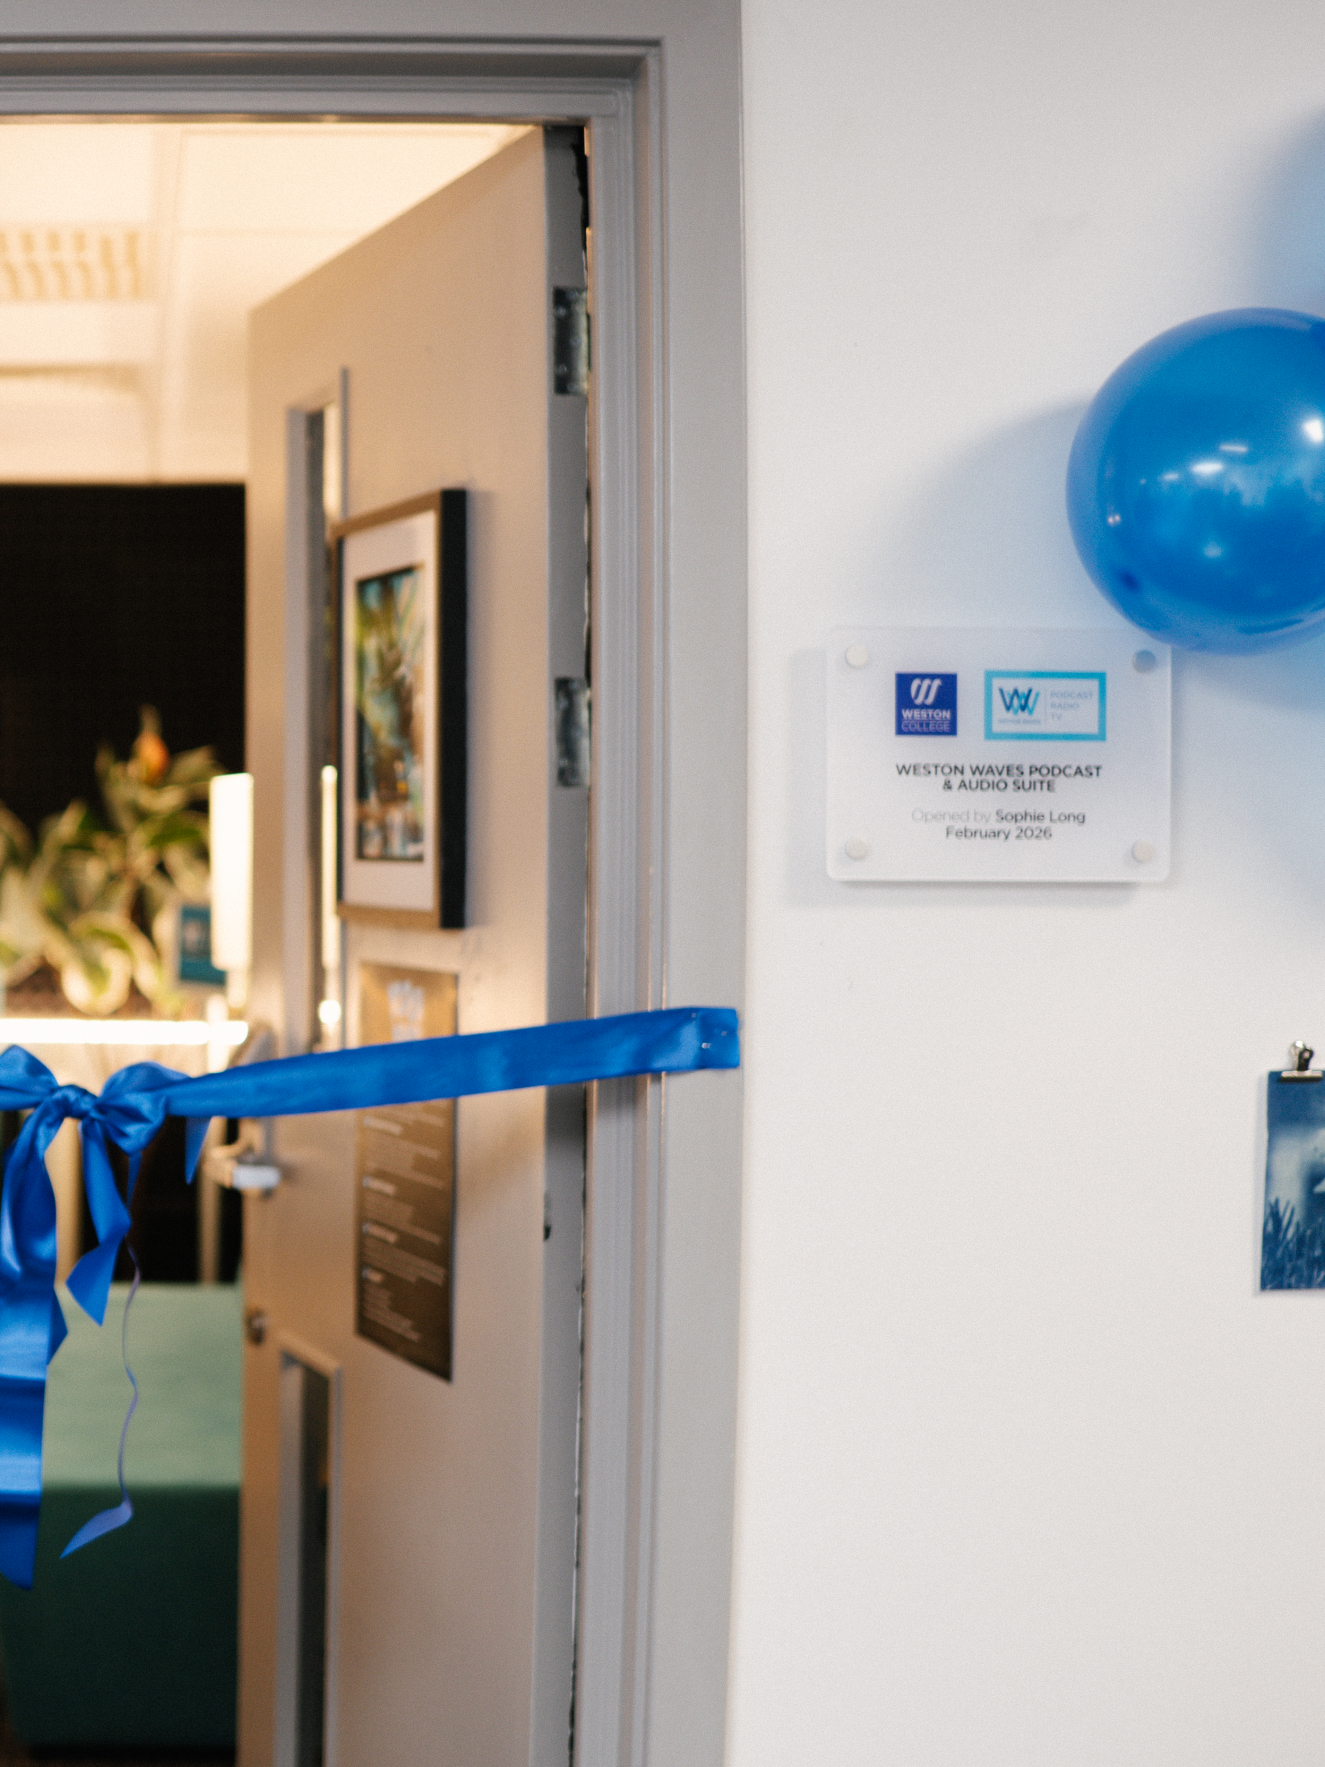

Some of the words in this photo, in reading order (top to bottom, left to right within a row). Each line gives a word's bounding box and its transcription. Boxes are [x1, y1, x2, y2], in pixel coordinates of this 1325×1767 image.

[1050, 690, 1094, 700] PODCAST
[1050, 702, 1080, 710] RADIO
[901, 708, 952, 720] WESTON
[1050, 712, 1063, 721] TV
[901, 720, 951, 733] COLLEGE
[895, 763, 965, 776] WESTON
[969, 763, 1024, 777] WAVES
[1028, 764, 1102, 778] PODCAST
[942, 779, 953, 792] &
[957, 779, 1008, 792] AUDIO
[1012, 779, 1056, 792] SUITE
[911, 807, 970, 823] Opened
[973, 808, 991, 823] by
[995, 808, 1045, 825] Sophie
[1049, 809, 1086, 827] Long
[945, 825, 1011, 842] February
[1015, 825, 1053, 840] 2026
